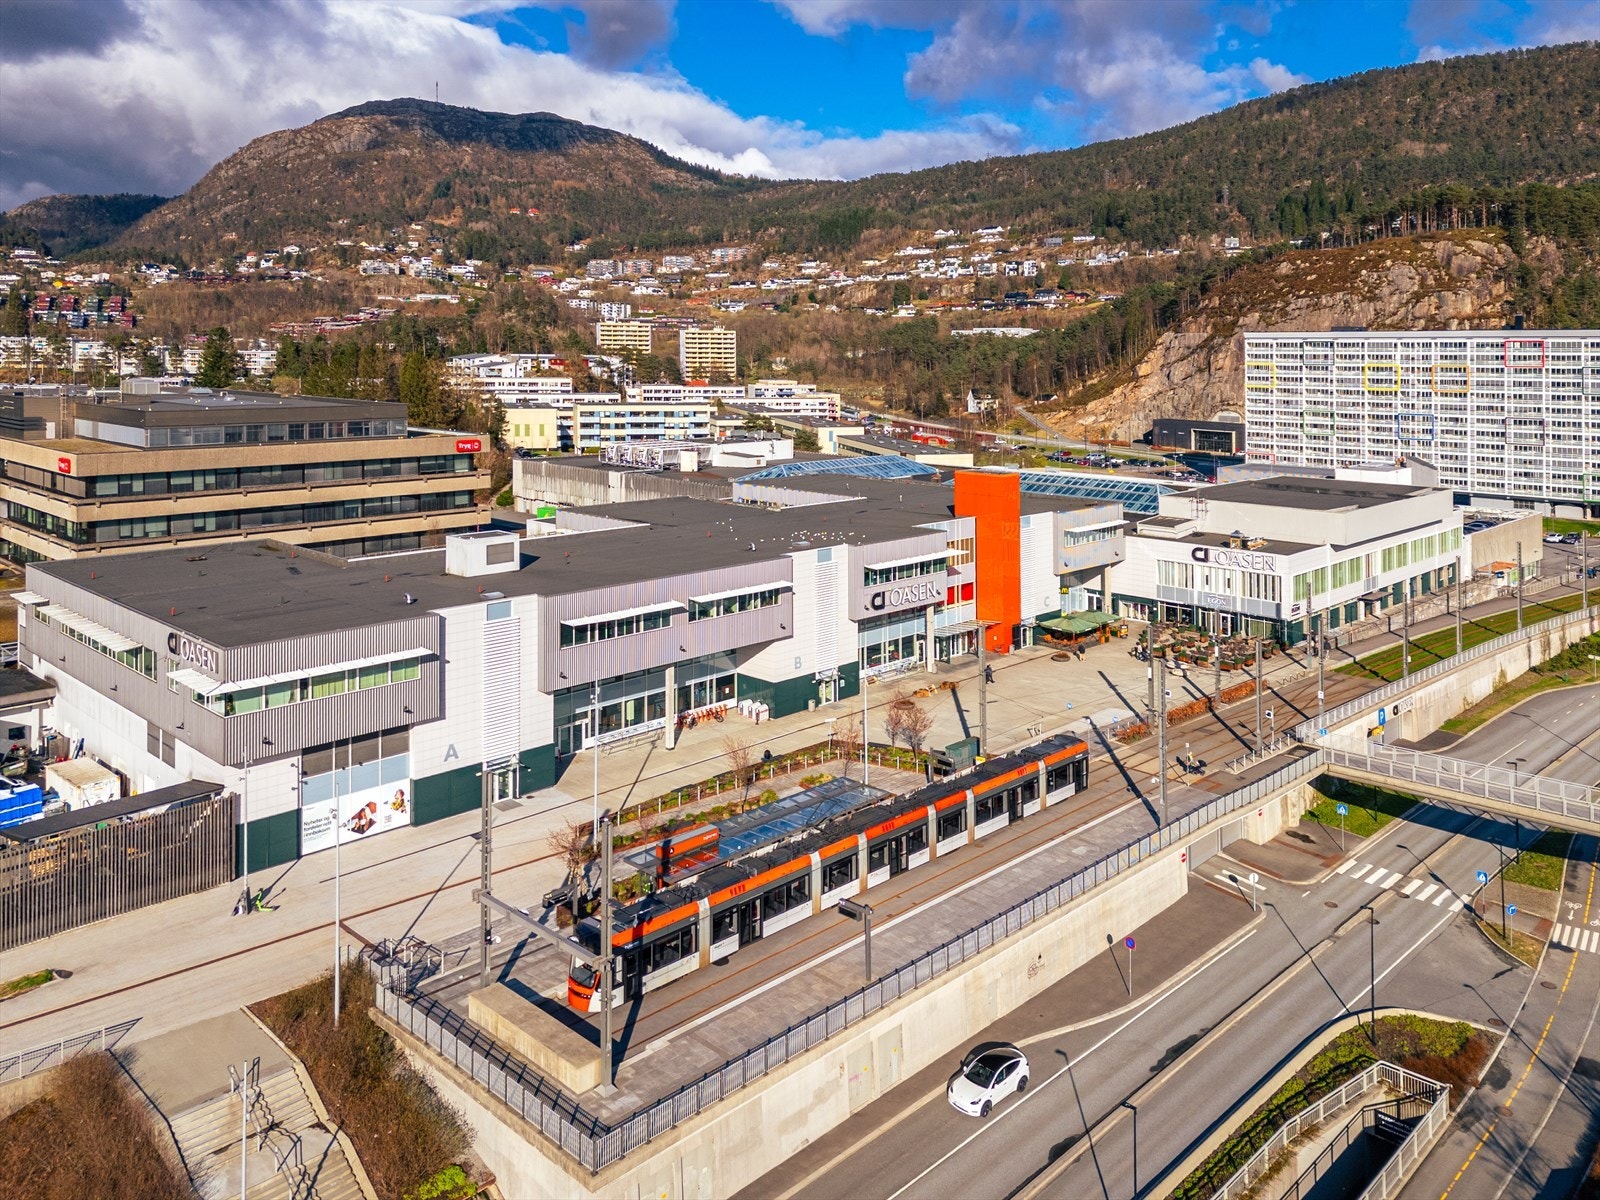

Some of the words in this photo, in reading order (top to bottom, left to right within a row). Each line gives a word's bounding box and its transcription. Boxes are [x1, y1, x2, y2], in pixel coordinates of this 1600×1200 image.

[1215, 550, 1276, 572] OASEN
[891, 581, 936, 606] OASEN
[1044, 596, 1050, 607] C
[1207, 597, 1226, 606] EGON
[181, 639, 217, 674] OASEN
[794, 656, 801, 669] B
[443, 743, 459, 762] A
[304, 818, 323, 826] Nyheter
